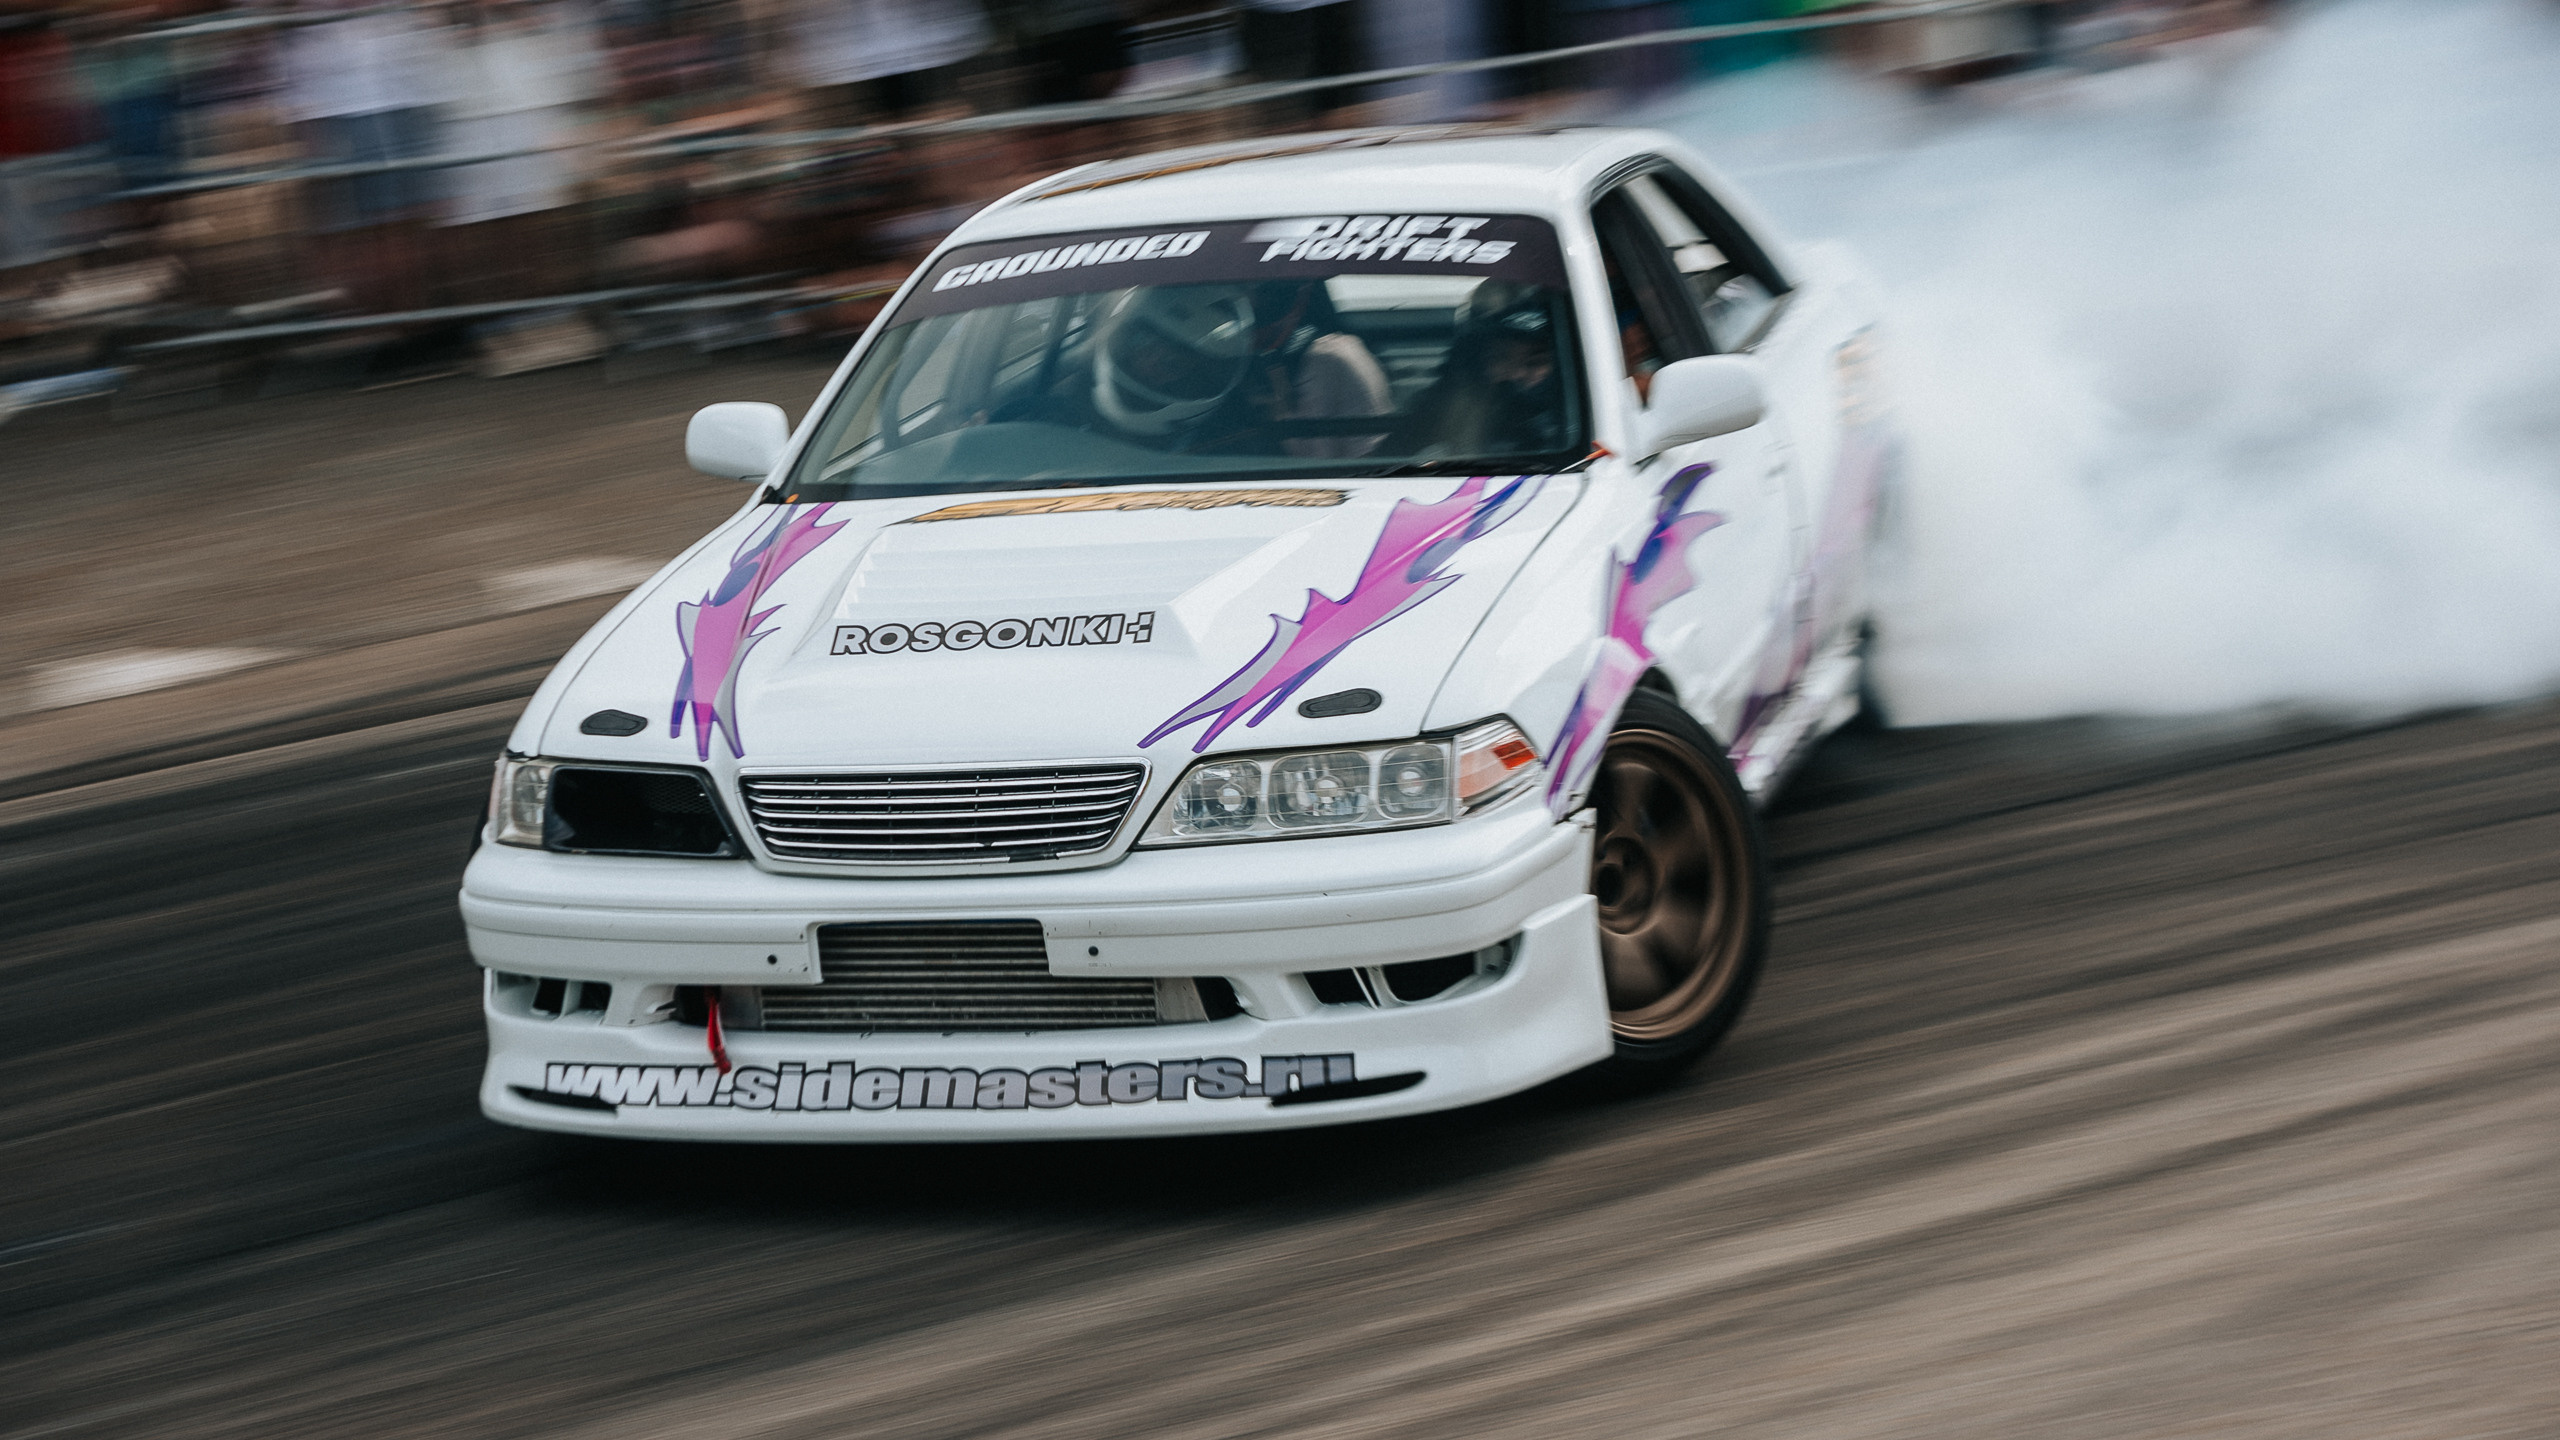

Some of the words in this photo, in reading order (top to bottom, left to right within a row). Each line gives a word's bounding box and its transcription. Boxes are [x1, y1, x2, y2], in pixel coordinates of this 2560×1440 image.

[1246, 215, 1491, 242] DRIFT
[932, 230, 1211, 292] GROUNDED
[1259, 237, 1518, 264] FIGHTERS
[830, 613, 1125, 656] ROSGONKI
[546, 1052, 1357, 1112] www.sidemasters.ru
